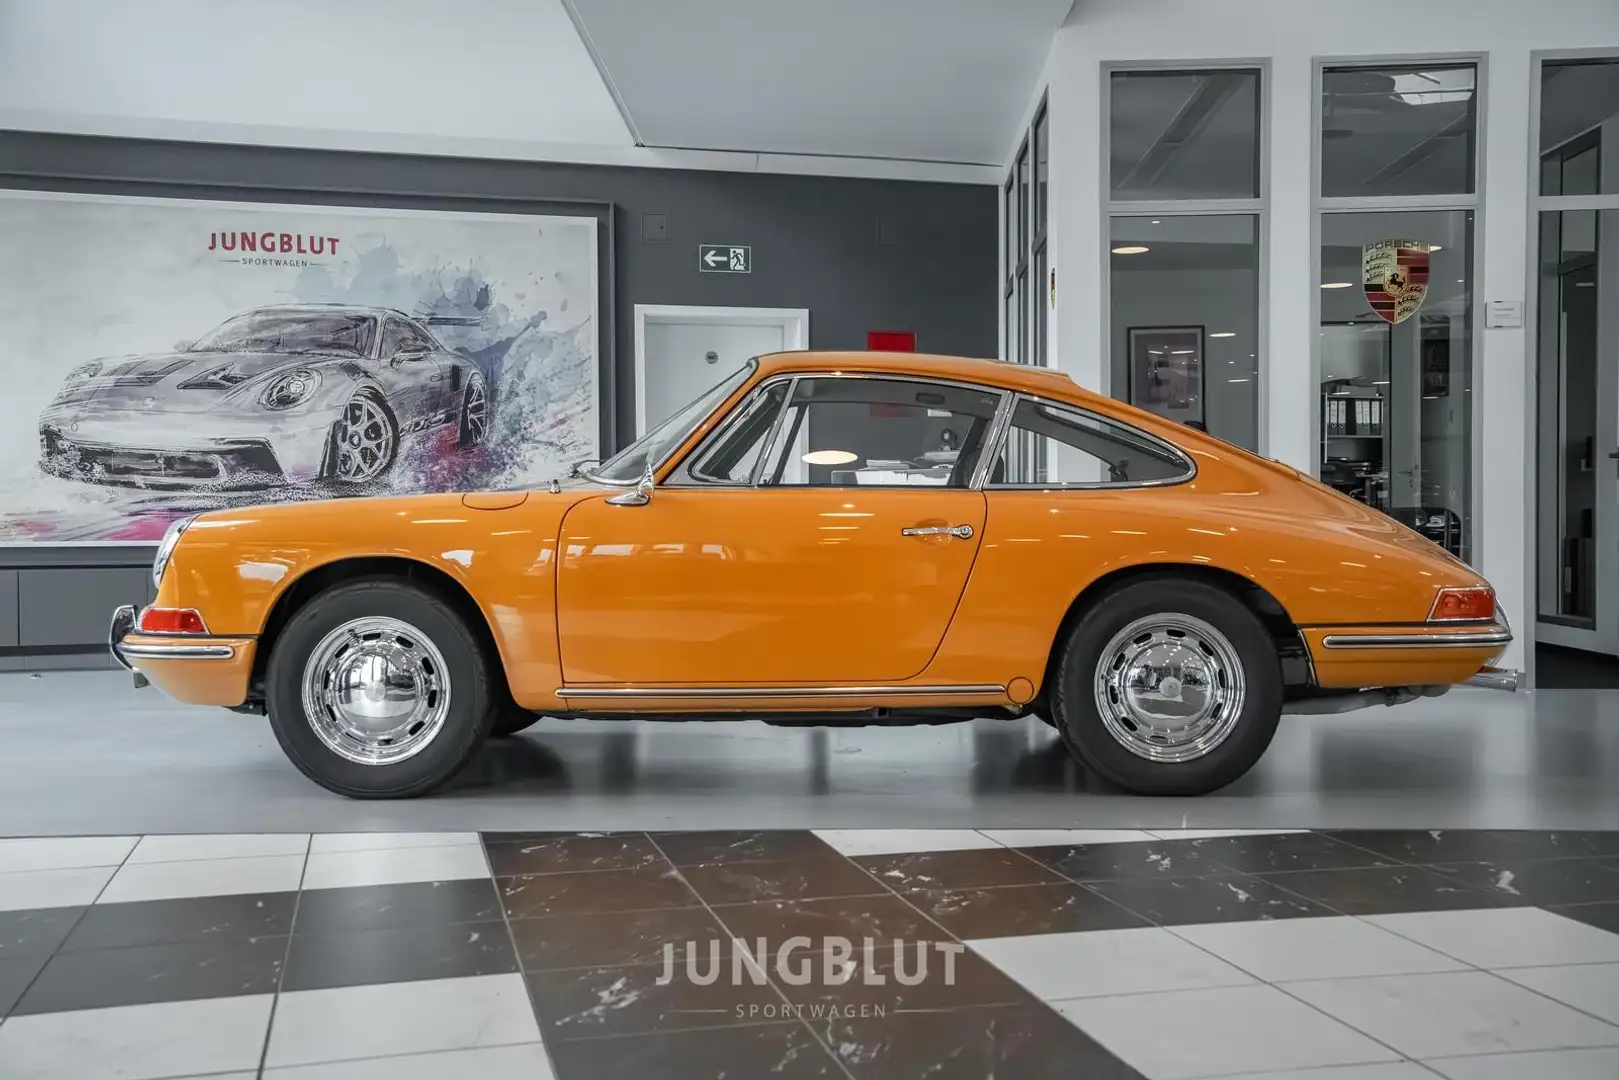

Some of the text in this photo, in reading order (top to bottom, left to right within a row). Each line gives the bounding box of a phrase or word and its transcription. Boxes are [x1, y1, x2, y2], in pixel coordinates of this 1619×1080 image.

[208, 232, 340, 255] JUNGBLUT
[1365, 239, 1428, 252] PORSCH
[241, 257, 308, 267] SPORTWAGEN
